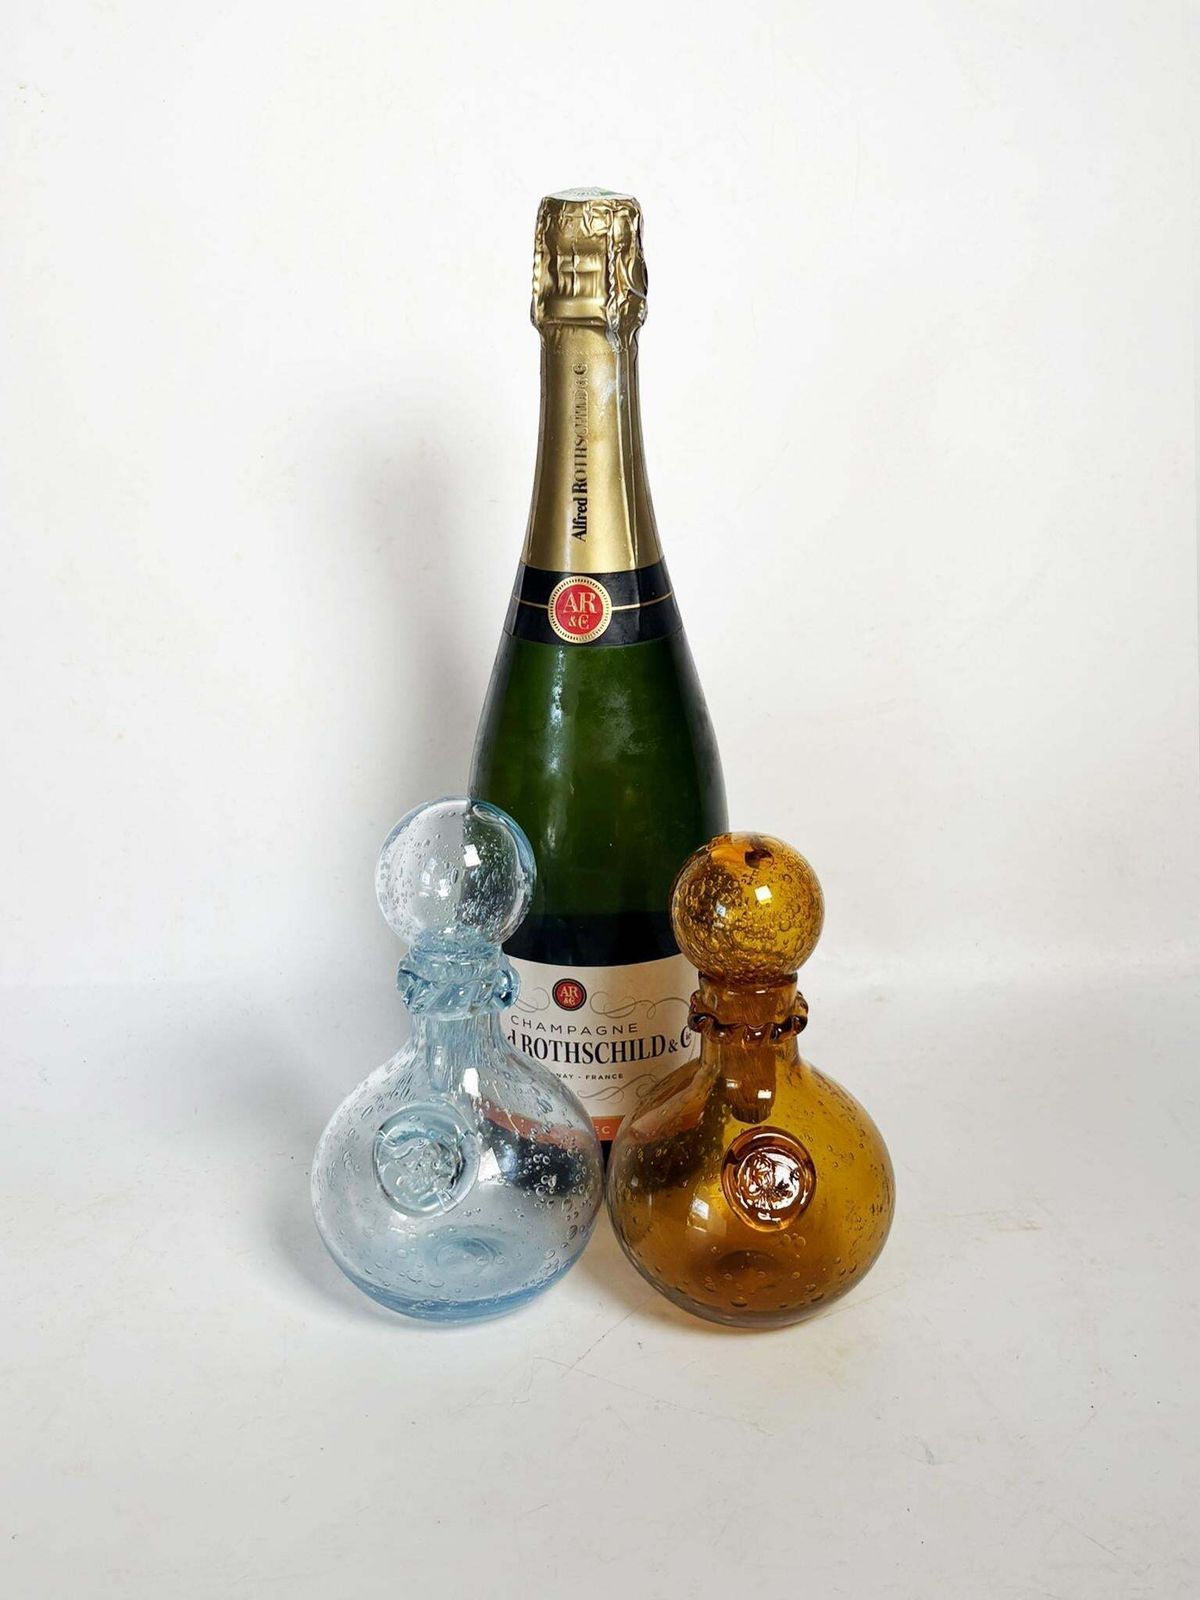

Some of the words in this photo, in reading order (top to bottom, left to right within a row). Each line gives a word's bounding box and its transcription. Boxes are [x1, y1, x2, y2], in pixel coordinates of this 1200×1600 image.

[571, 497, 588, 542] Alfred
[563, 591, 597, 613] AR
[560, 985, 579, 998] AR
[510, 1014, 638, 1036] CHAMPAGNE
[520, 1033, 667, 1065] ROTHSCHILD
[585, 1072, 624, 1080] FRANCE
